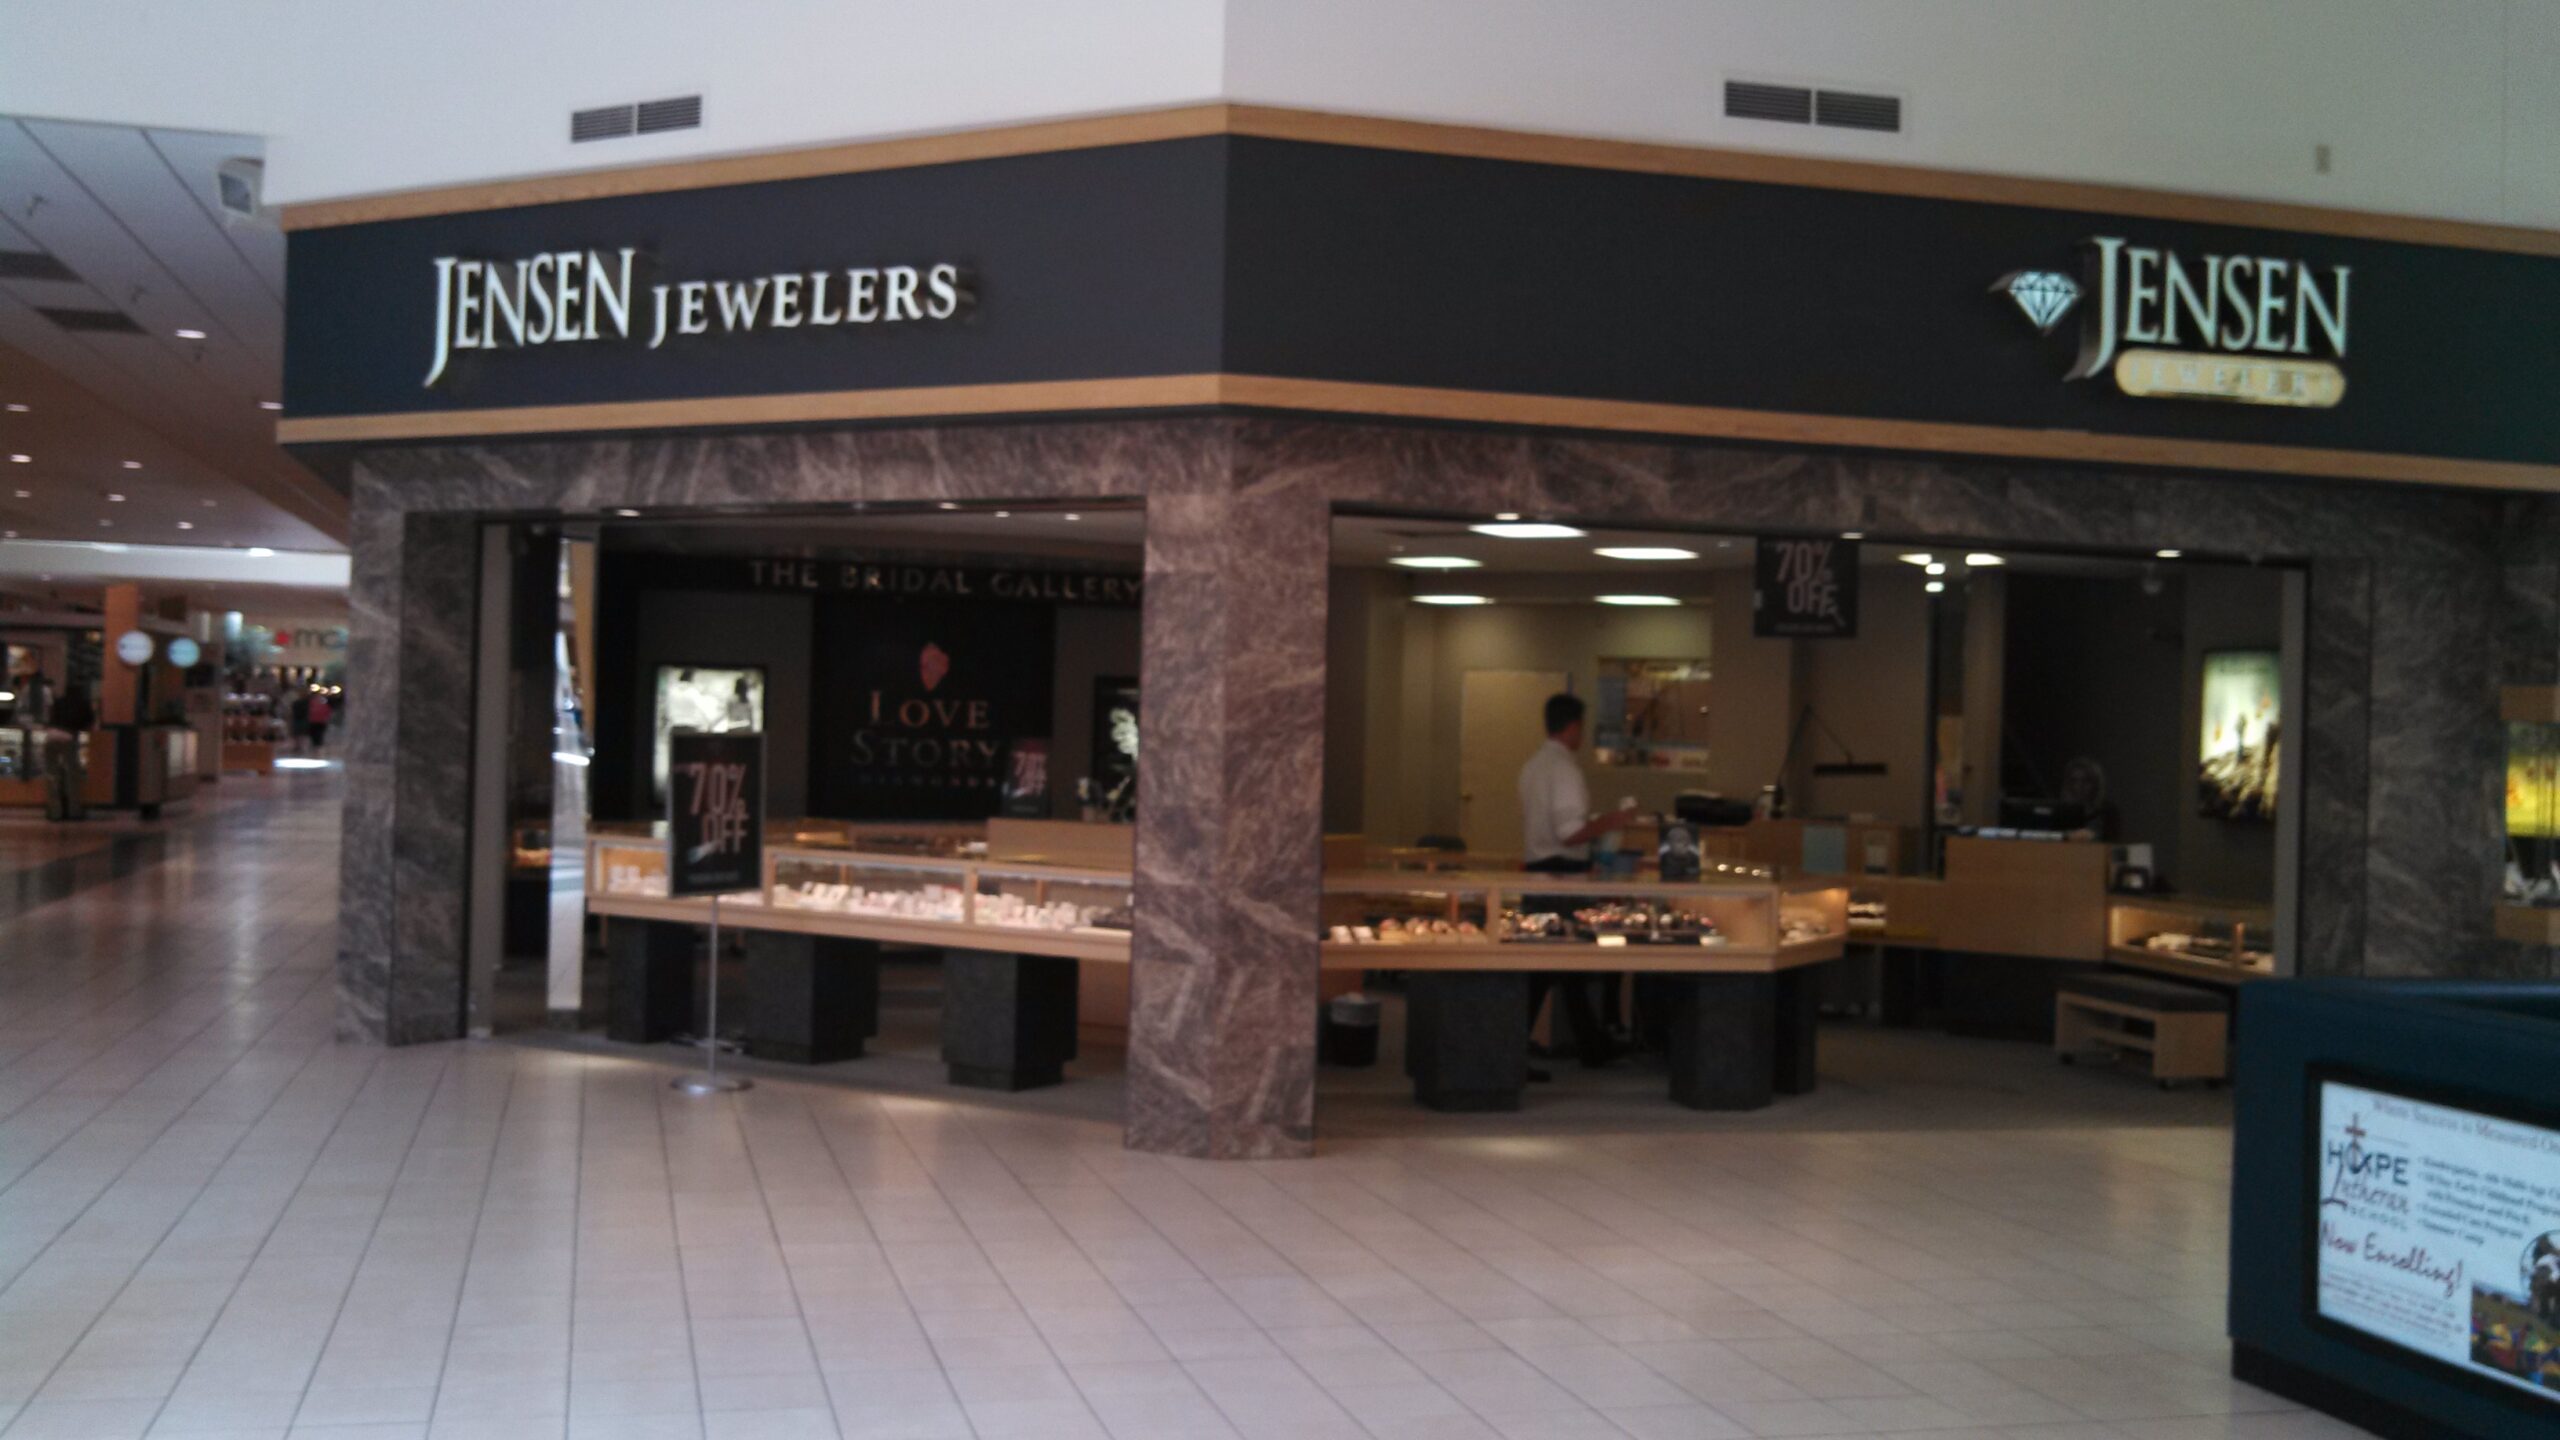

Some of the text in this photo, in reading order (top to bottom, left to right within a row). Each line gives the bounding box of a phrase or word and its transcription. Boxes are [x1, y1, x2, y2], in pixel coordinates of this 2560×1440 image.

[423, 247, 959, 388] JENSEN JEWELERS
[2082, 235, 2352, 380] JENSEN
[749, 559, 1144, 602] THE BRIDAL GALLERY
[1775, 540, 1835, 583] 70%
[866, 688, 991, 729] LOVE
[850, 729, 1000, 768] STORY
[687, 761, 748, 816] 70%
